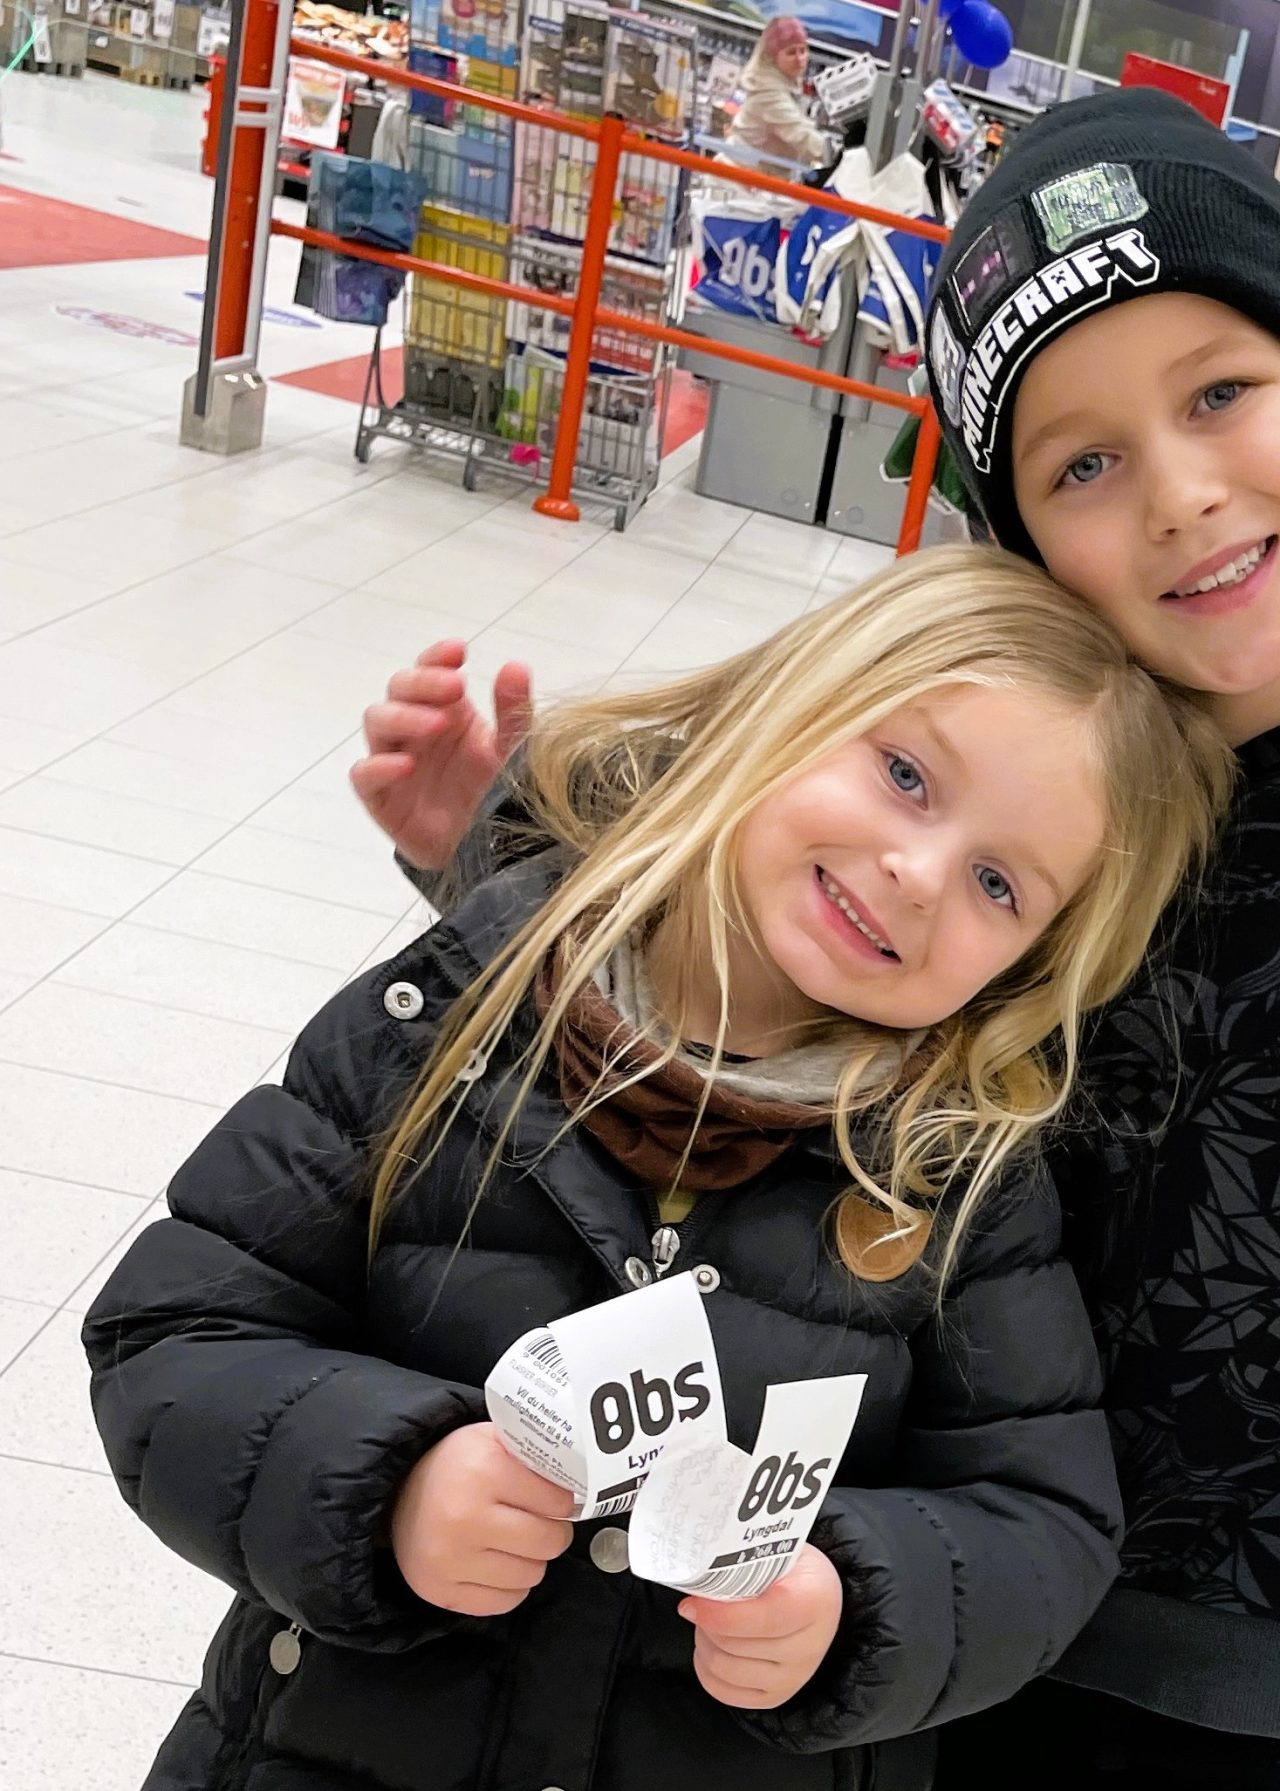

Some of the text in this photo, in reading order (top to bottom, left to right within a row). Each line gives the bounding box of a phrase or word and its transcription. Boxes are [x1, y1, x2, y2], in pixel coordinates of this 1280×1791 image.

[719, 237, 775, 301] Ob
[961, 230, 1158, 468] MINECRAFT
[527, 1394, 539, 1408] du
[590, 1361, 711, 1455] Obs
[628, 1445, 664, 1473] Lyn
[738, 1451, 832, 1522] Obs
[743, 1517, 793, 1542] Lyngdal
